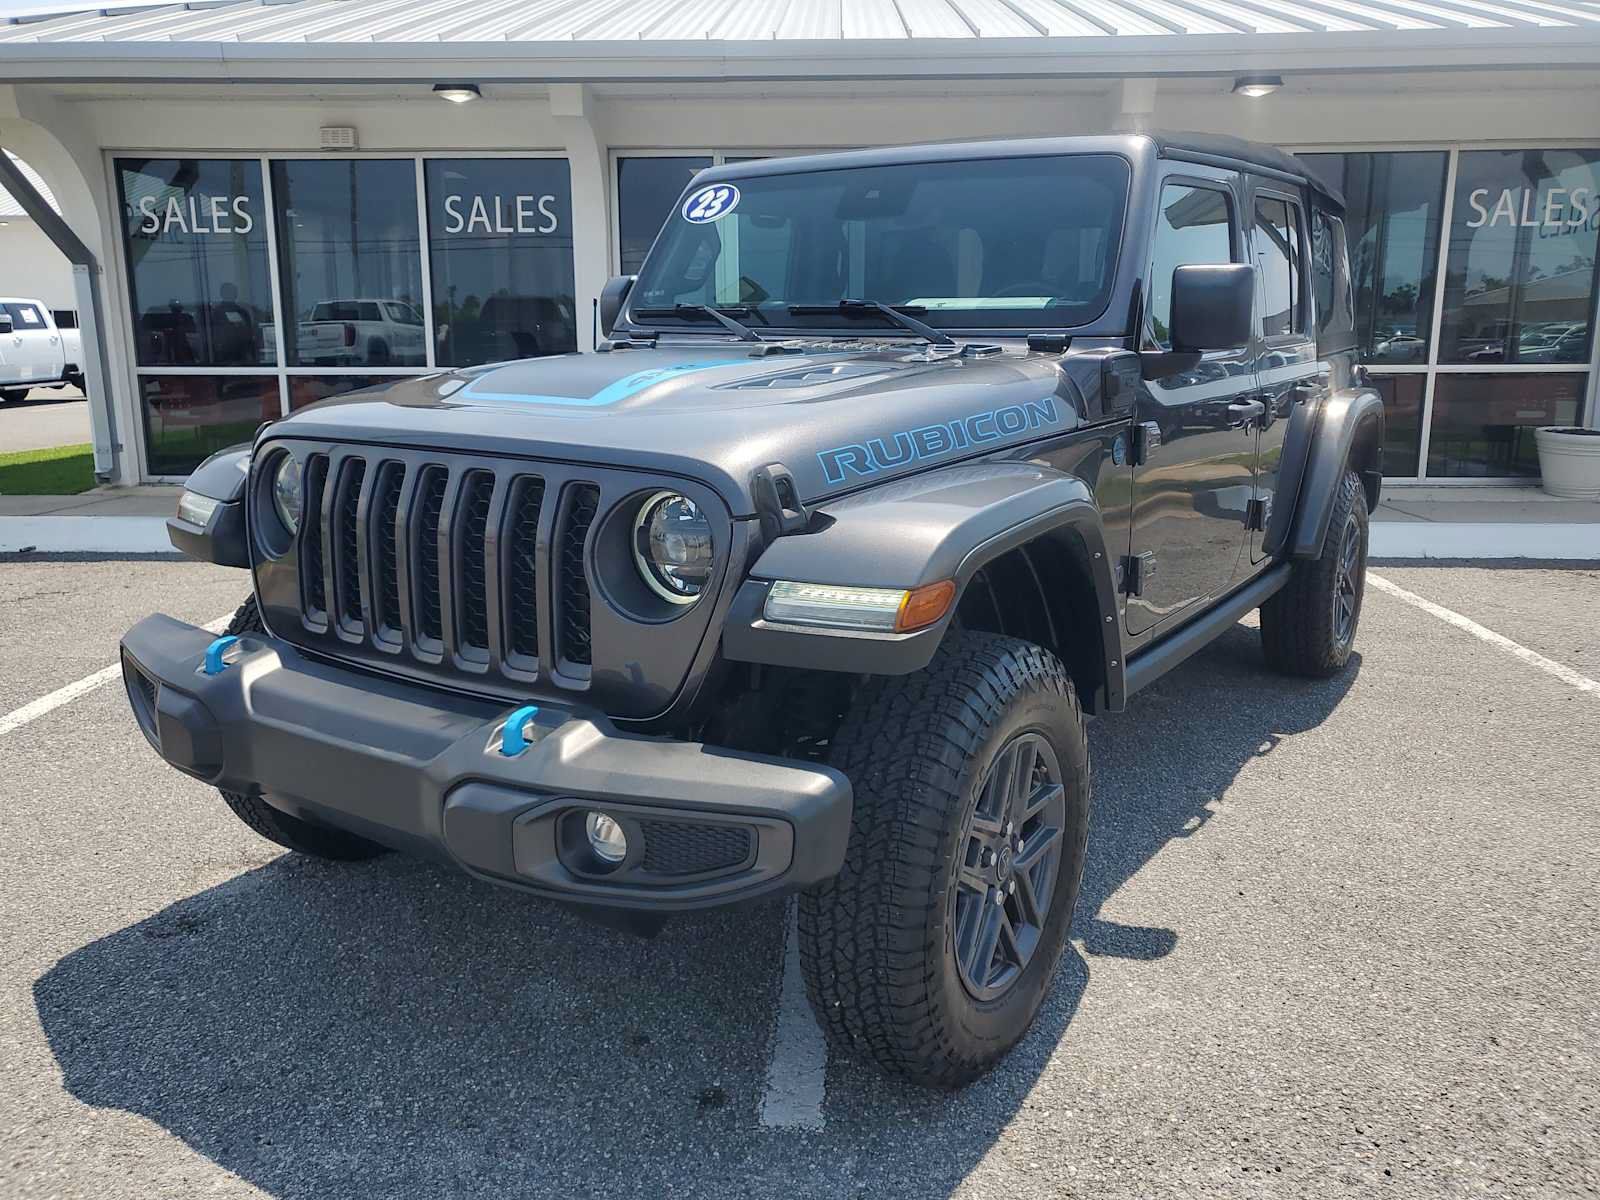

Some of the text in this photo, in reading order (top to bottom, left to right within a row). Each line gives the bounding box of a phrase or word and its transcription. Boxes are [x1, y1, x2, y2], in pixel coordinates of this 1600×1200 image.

[139, 195, 253, 234] SALES
[444, 195, 558, 233] SALES
[689, 188, 730, 219] 23
[1466, 188, 1589, 228] SALES
[816, 398, 1060, 484] RUBICON
